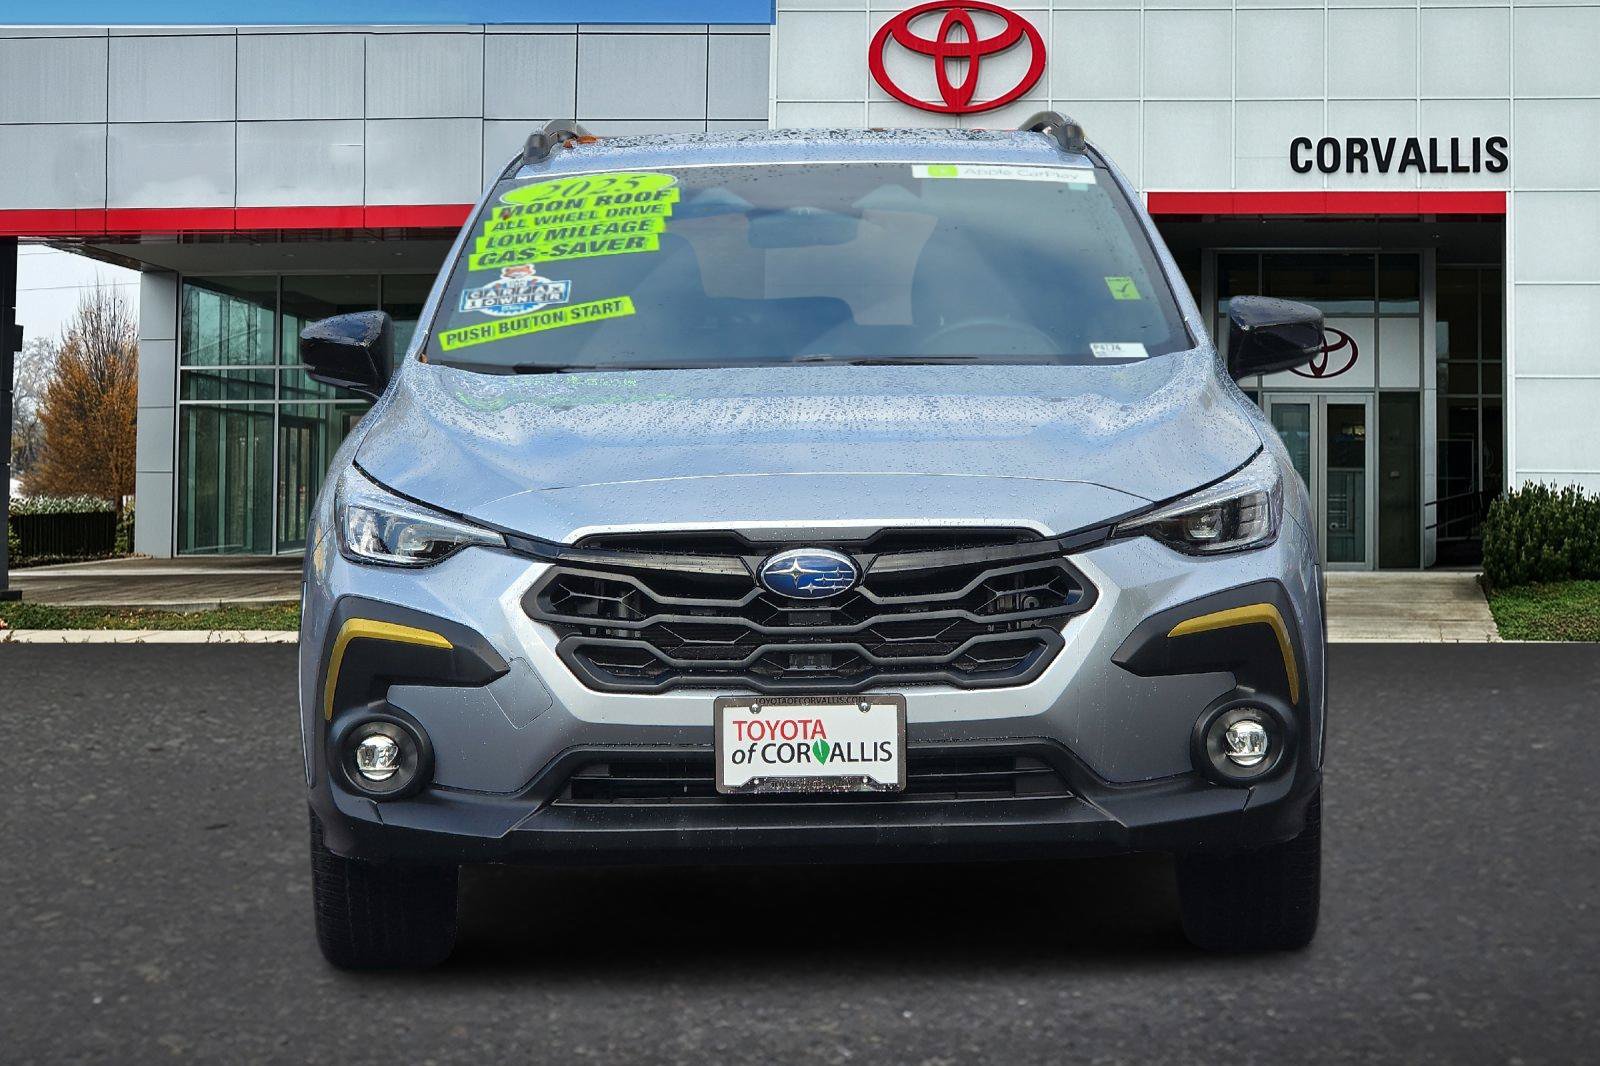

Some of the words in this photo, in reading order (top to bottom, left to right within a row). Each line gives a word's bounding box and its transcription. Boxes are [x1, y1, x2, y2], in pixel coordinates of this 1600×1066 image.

[1290, 136, 1509, 174] CORVALLIS
[532, 175, 647, 201] 2025
[491, 218, 529, 232] ALL
[534, 210, 601, 226] WHEEL
[605, 204, 664, 218] DRIVE
[499, 197, 584, 220] MOON
[594, 188, 672, 205] ROOF
[485, 232, 538, 250] LOW
[543, 218, 653, 242] MILEAGE
[477, 236, 646, 267] GAS-SAVER
[446, 326, 492, 346] PUSH
[498, 311, 564, 334] BUTTON
[571, 301, 623, 319] START
[732, 719, 827, 742] TOYOTA
[731, 742, 757, 765] of
